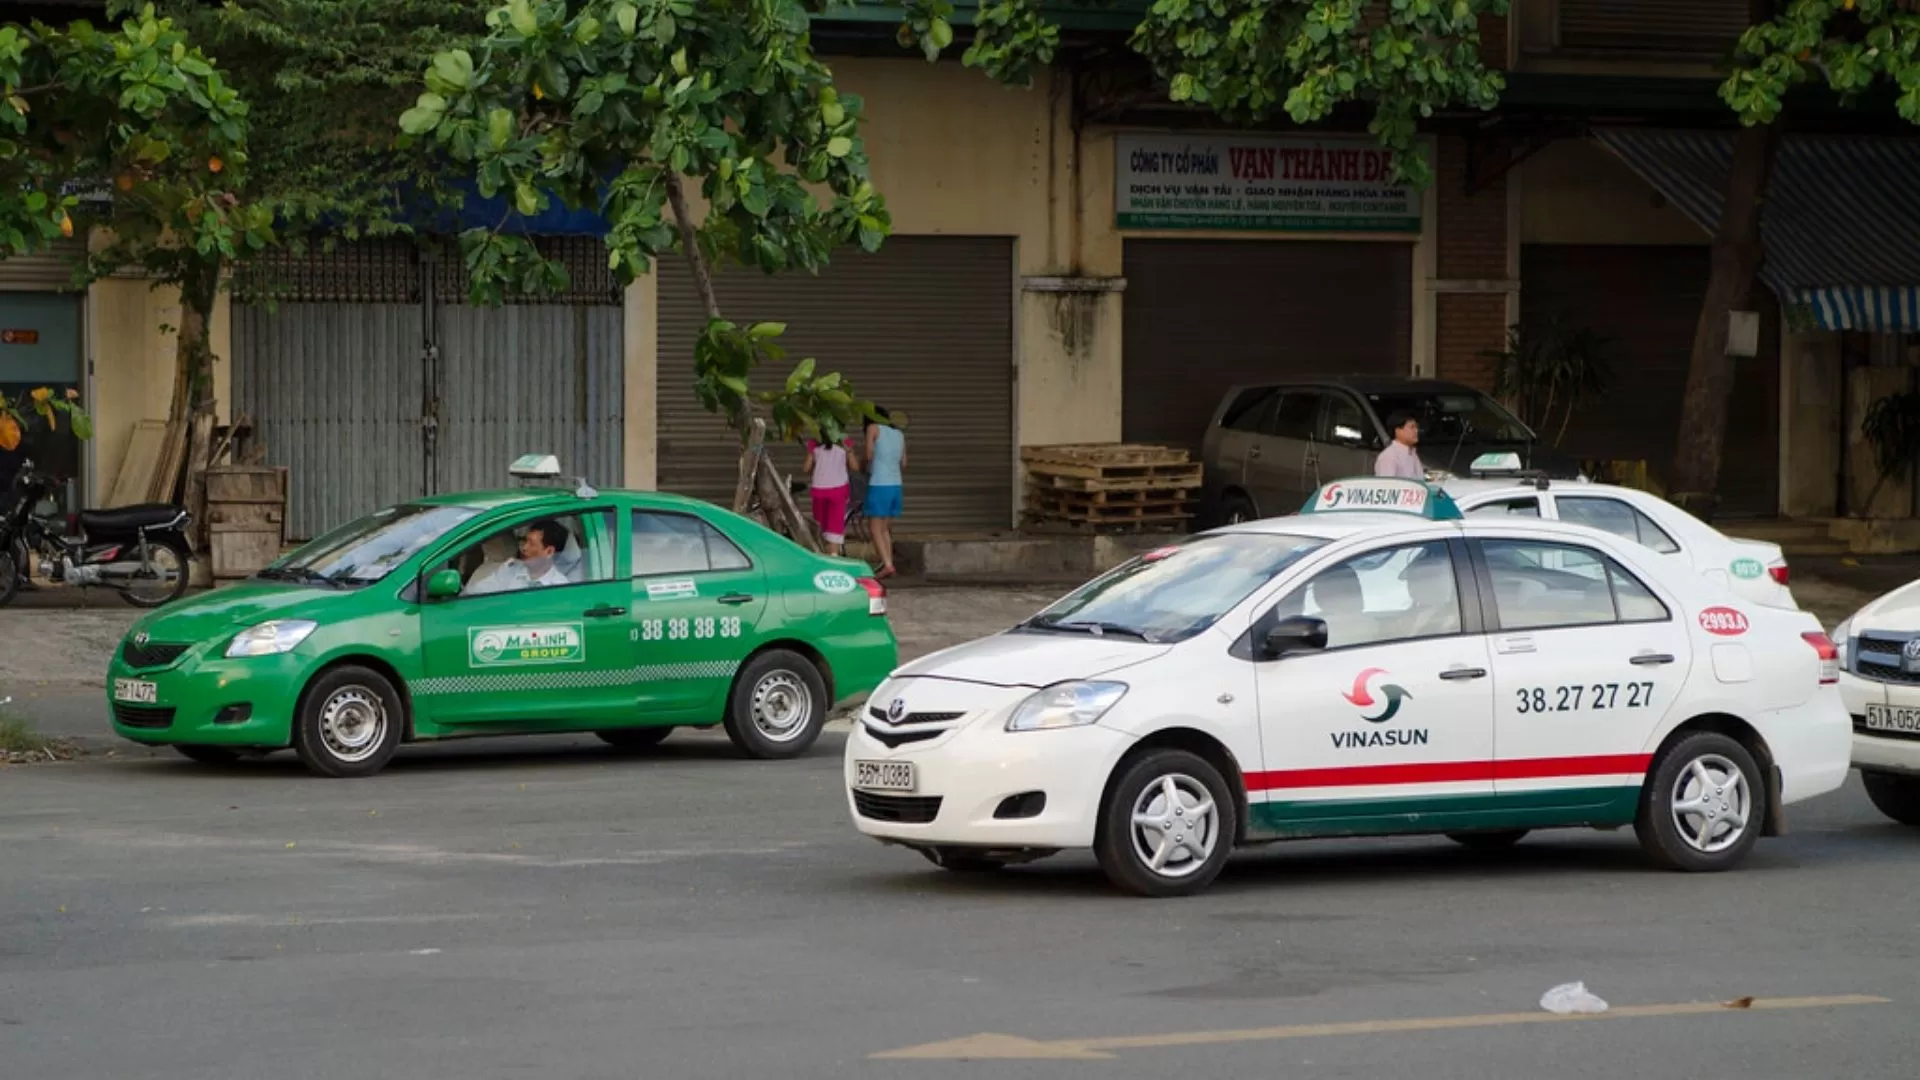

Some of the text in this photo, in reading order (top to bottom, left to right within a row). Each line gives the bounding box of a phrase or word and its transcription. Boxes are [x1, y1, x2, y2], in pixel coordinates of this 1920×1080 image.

[1160, 152, 1175, 174] TY
[1228, 147, 1275, 184] VẠN
[1280, 143, 1359, 181] THÀNH
[1245, 186, 1276, 197] GIAO
[1346, 489, 1425, 506] VINASUN TAXI
[642, 619, 663, 641] 38
[668, 618, 689, 640] 38
[694, 617, 715, 639] 38
[720, 616, 741, 638] 38
[521, 648, 568, 658] GROUP
[1516, 682, 1655, 713] 38.27 27 27
[1331, 728, 1428, 749] VINASUN
